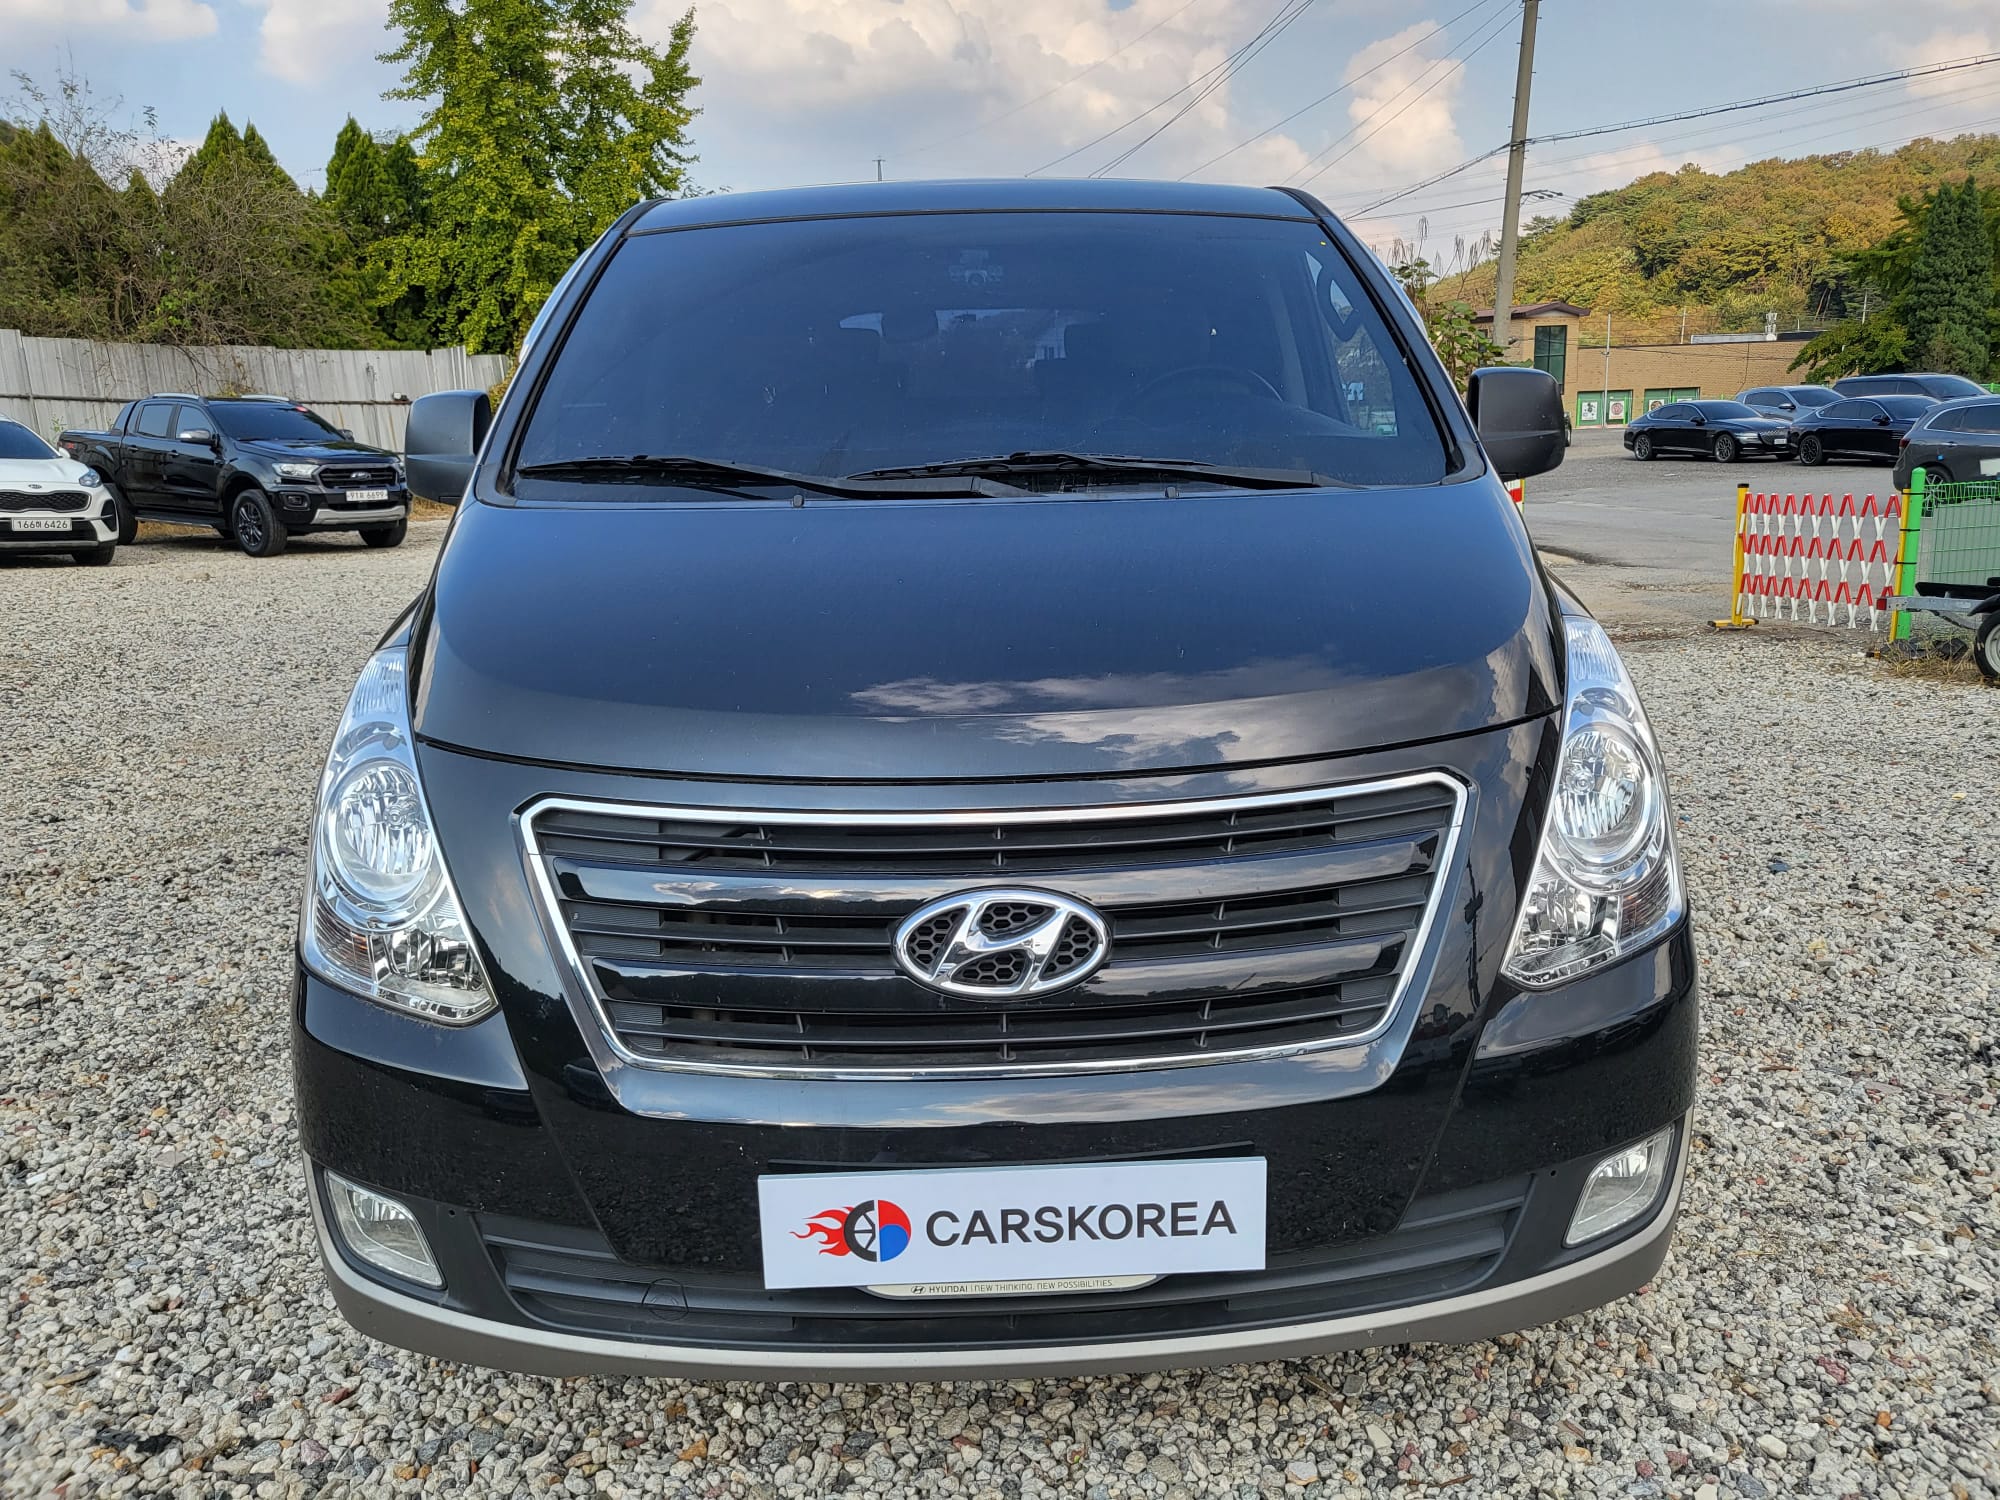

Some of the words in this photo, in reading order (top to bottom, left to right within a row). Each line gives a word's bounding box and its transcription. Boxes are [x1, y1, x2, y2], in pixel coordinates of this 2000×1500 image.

[44, 521, 68, 529] 6426
[925, 1199, 1239, 1248] CARSKOREA
[928, 1285, 968, 1294] HYUNDAI
[974, 1284, 993, 1292] NEW
[1036, 1281, 1056, 1290] NEW
